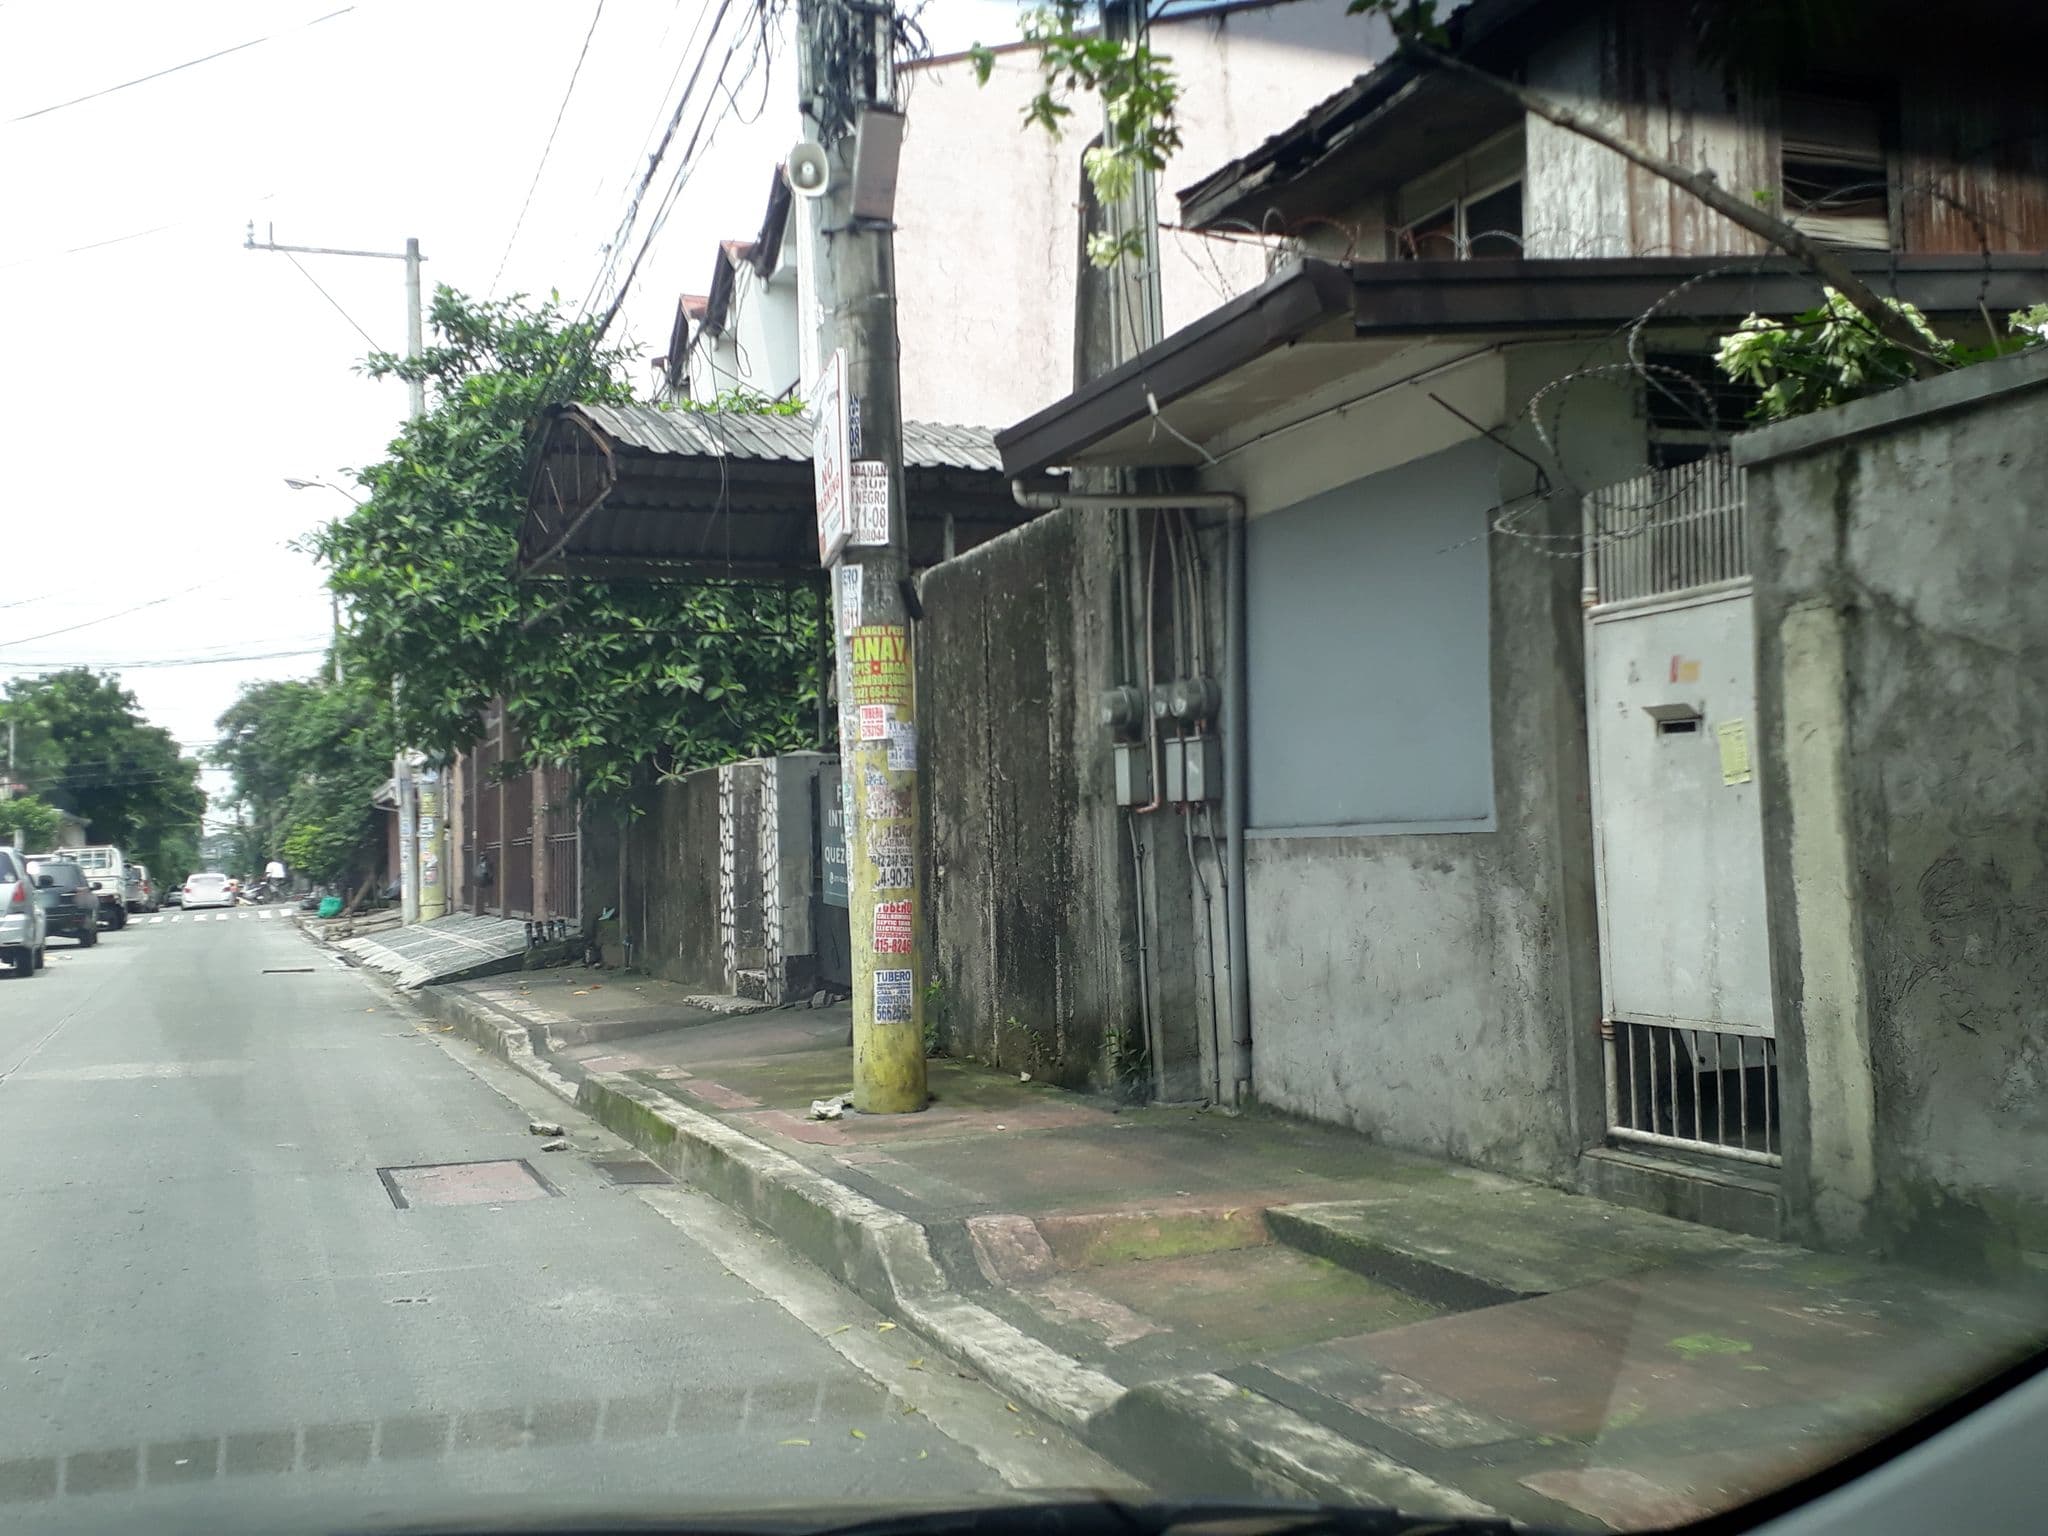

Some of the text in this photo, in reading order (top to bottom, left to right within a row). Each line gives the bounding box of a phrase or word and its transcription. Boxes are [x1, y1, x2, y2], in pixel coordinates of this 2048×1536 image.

[822, 457, 833, 489] NO
[856, 491, 886, 505] NEGRO
[853, 636, 905, 661] ANAY
[876, 971, 911, 982] TUBERO
